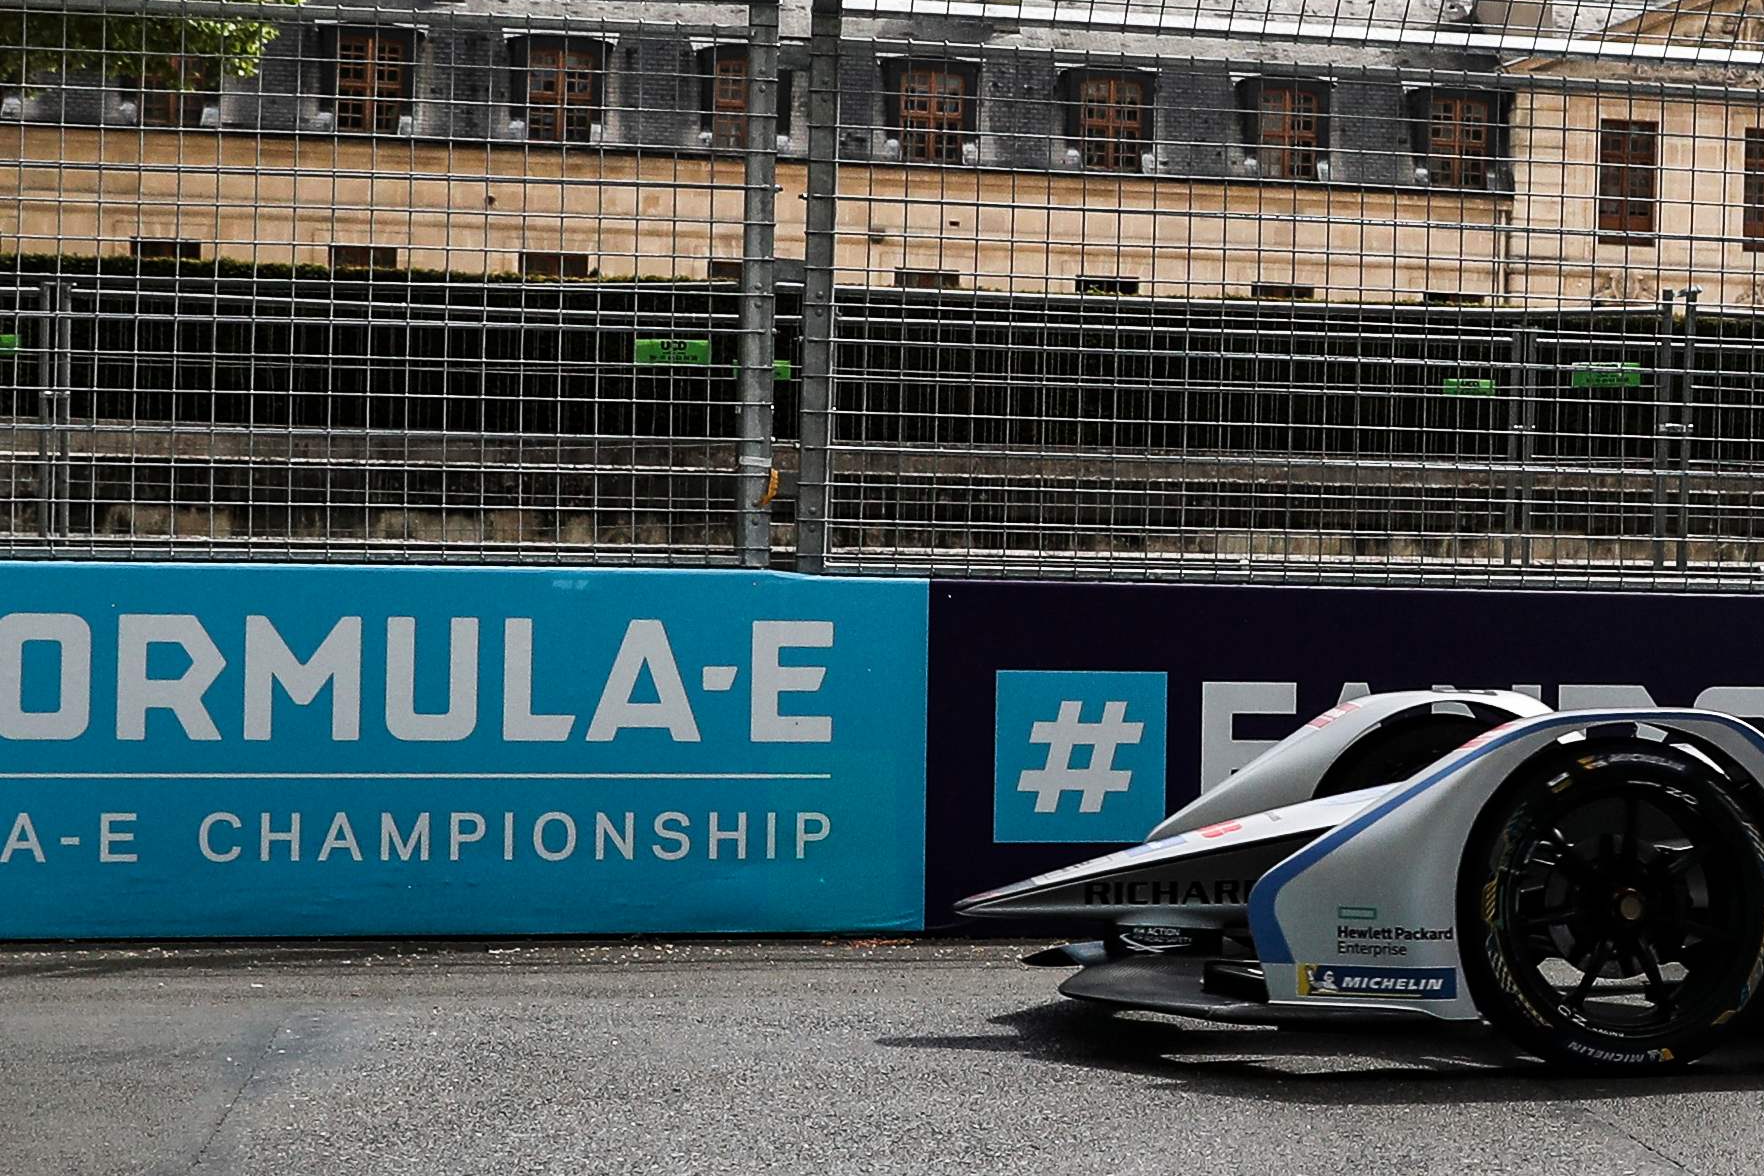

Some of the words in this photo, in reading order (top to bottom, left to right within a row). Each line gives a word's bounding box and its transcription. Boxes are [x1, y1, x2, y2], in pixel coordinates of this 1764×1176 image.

[199, 811, 831, 862] CHAMPIONSHIP
[1337, 925, 1392, 939] Hewlett
[1395, 927, 1453, 940] Packard
[1338, 941, 1407, 957] Enterprise
[1341, 977, 1444, 990] MICHELIN
[1568, 1040, 1644, 1063] MICHELIN
